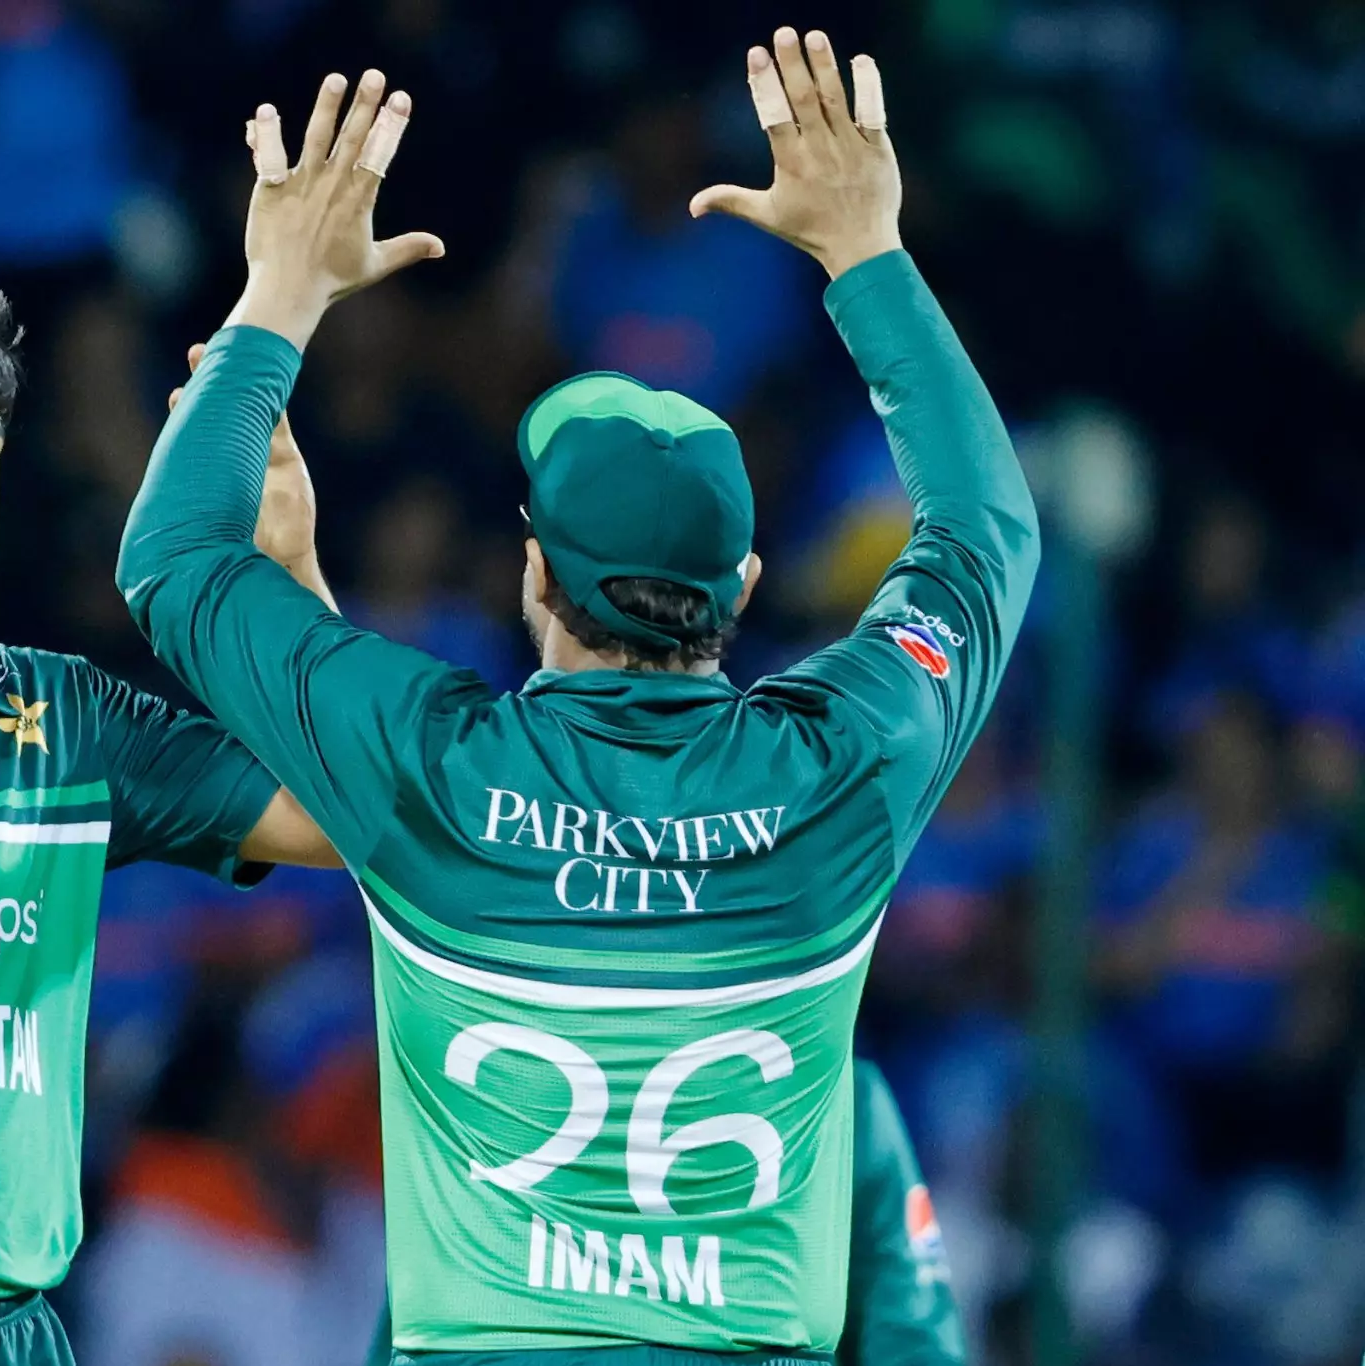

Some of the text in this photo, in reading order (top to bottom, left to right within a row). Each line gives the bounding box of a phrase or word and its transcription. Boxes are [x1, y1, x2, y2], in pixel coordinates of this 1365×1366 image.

[478, 787, 786, 862] PARKVIEW
[555, 858, 712, 913] CITY
[444, 1021, 795, 1216] 26
[527, 1213, 725, 1308] IMAM
